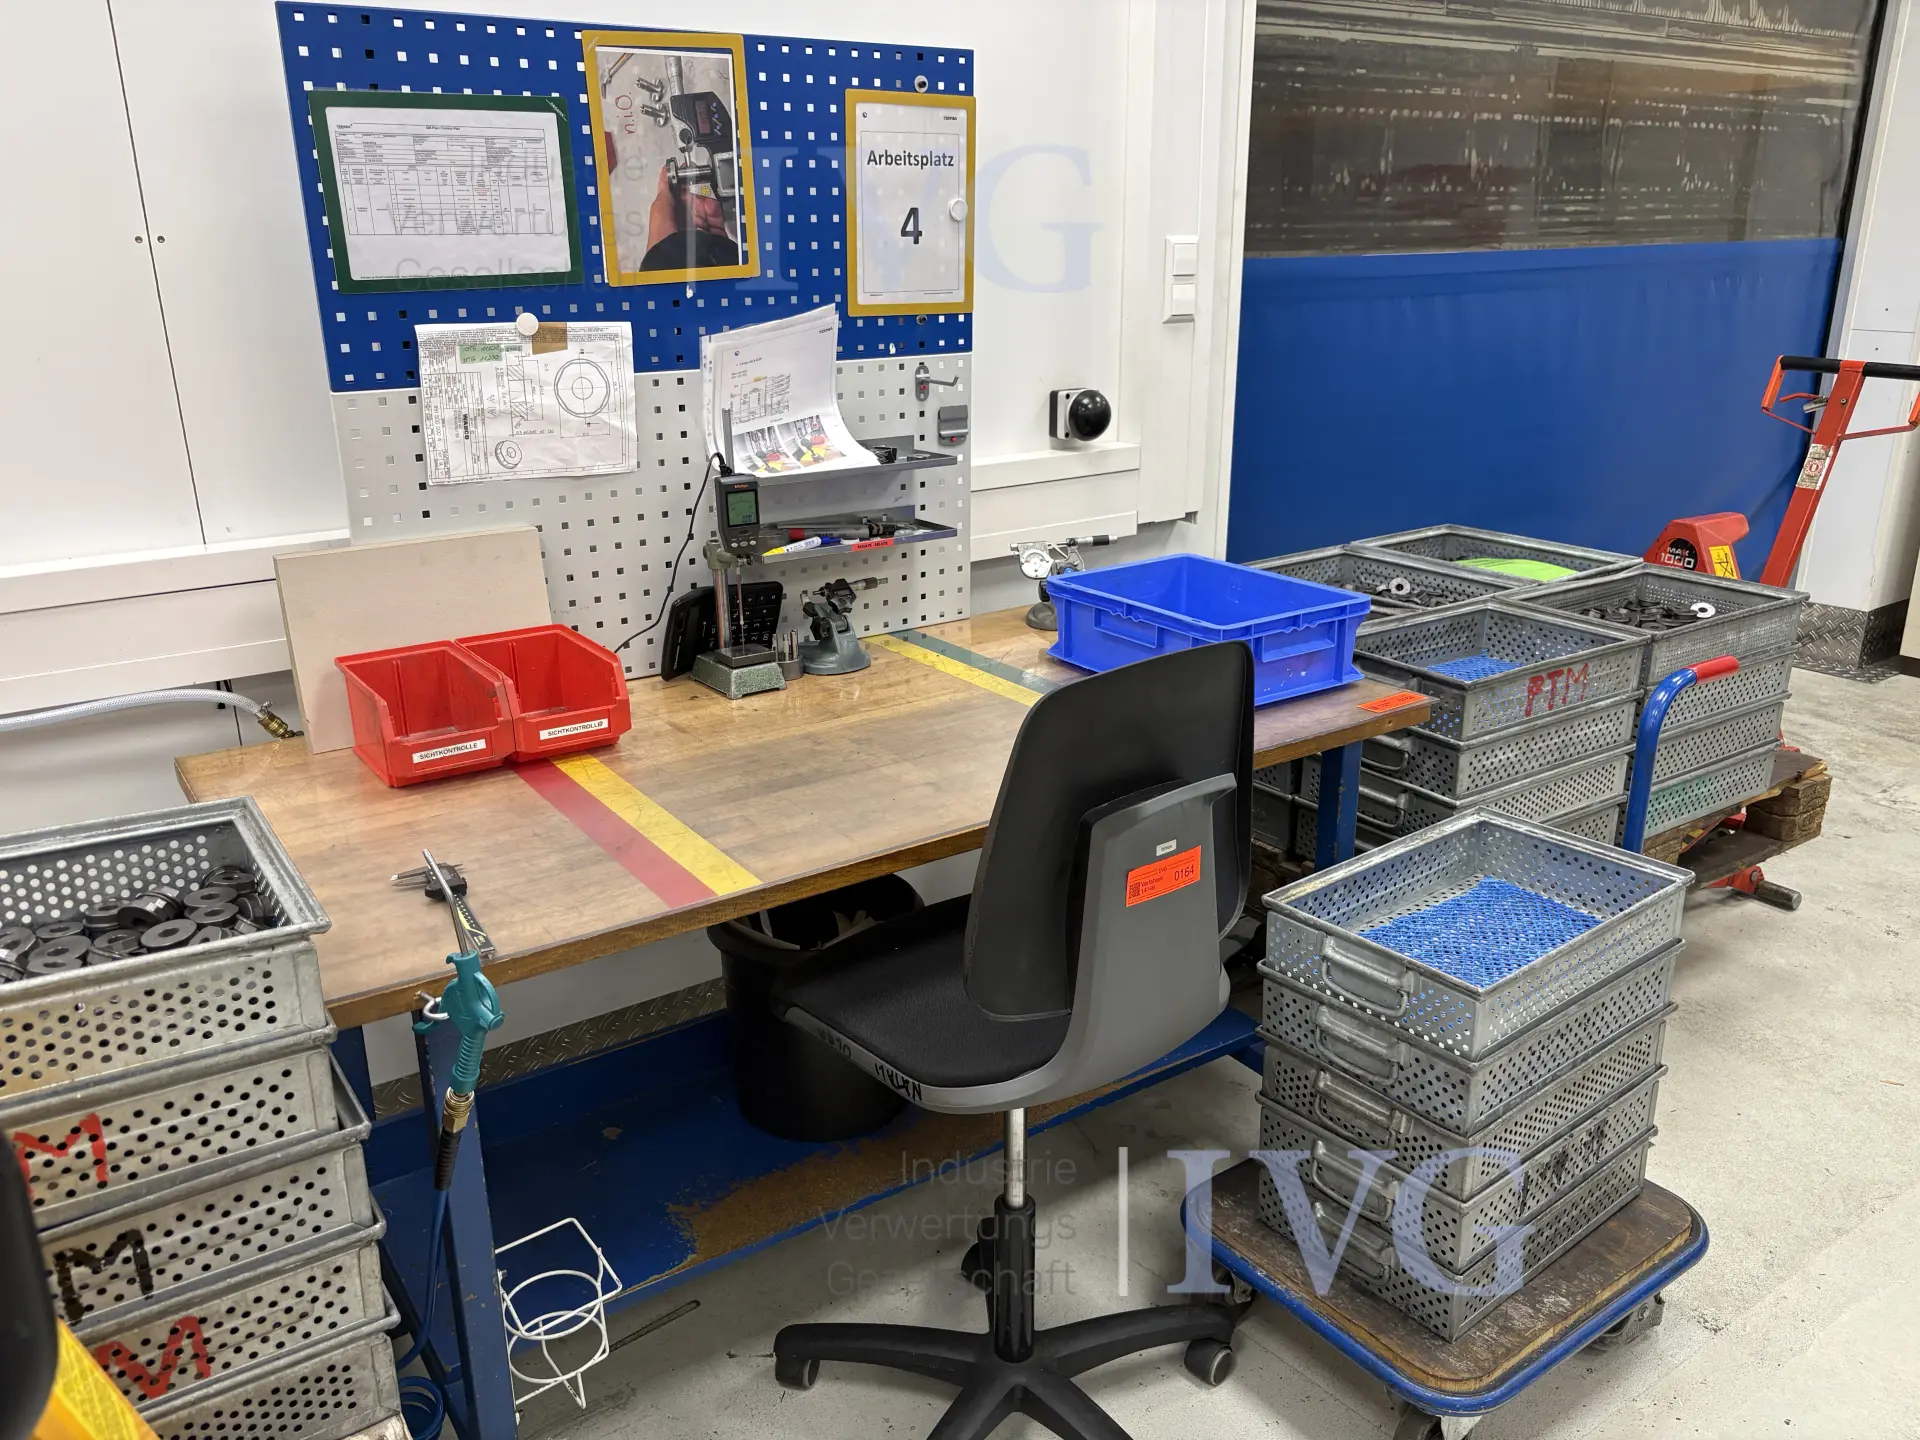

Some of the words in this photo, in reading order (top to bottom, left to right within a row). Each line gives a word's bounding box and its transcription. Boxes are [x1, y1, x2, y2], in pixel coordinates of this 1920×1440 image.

[866, 149, 954, 170] Arbeitsplatz
[900, 207, 923, 245] 4
[1524, 662, 1589, 718] PTM
[419, 742, 478, 760] SICHTKONTROLLE
[1174, 863, 1195, 882] 0164
